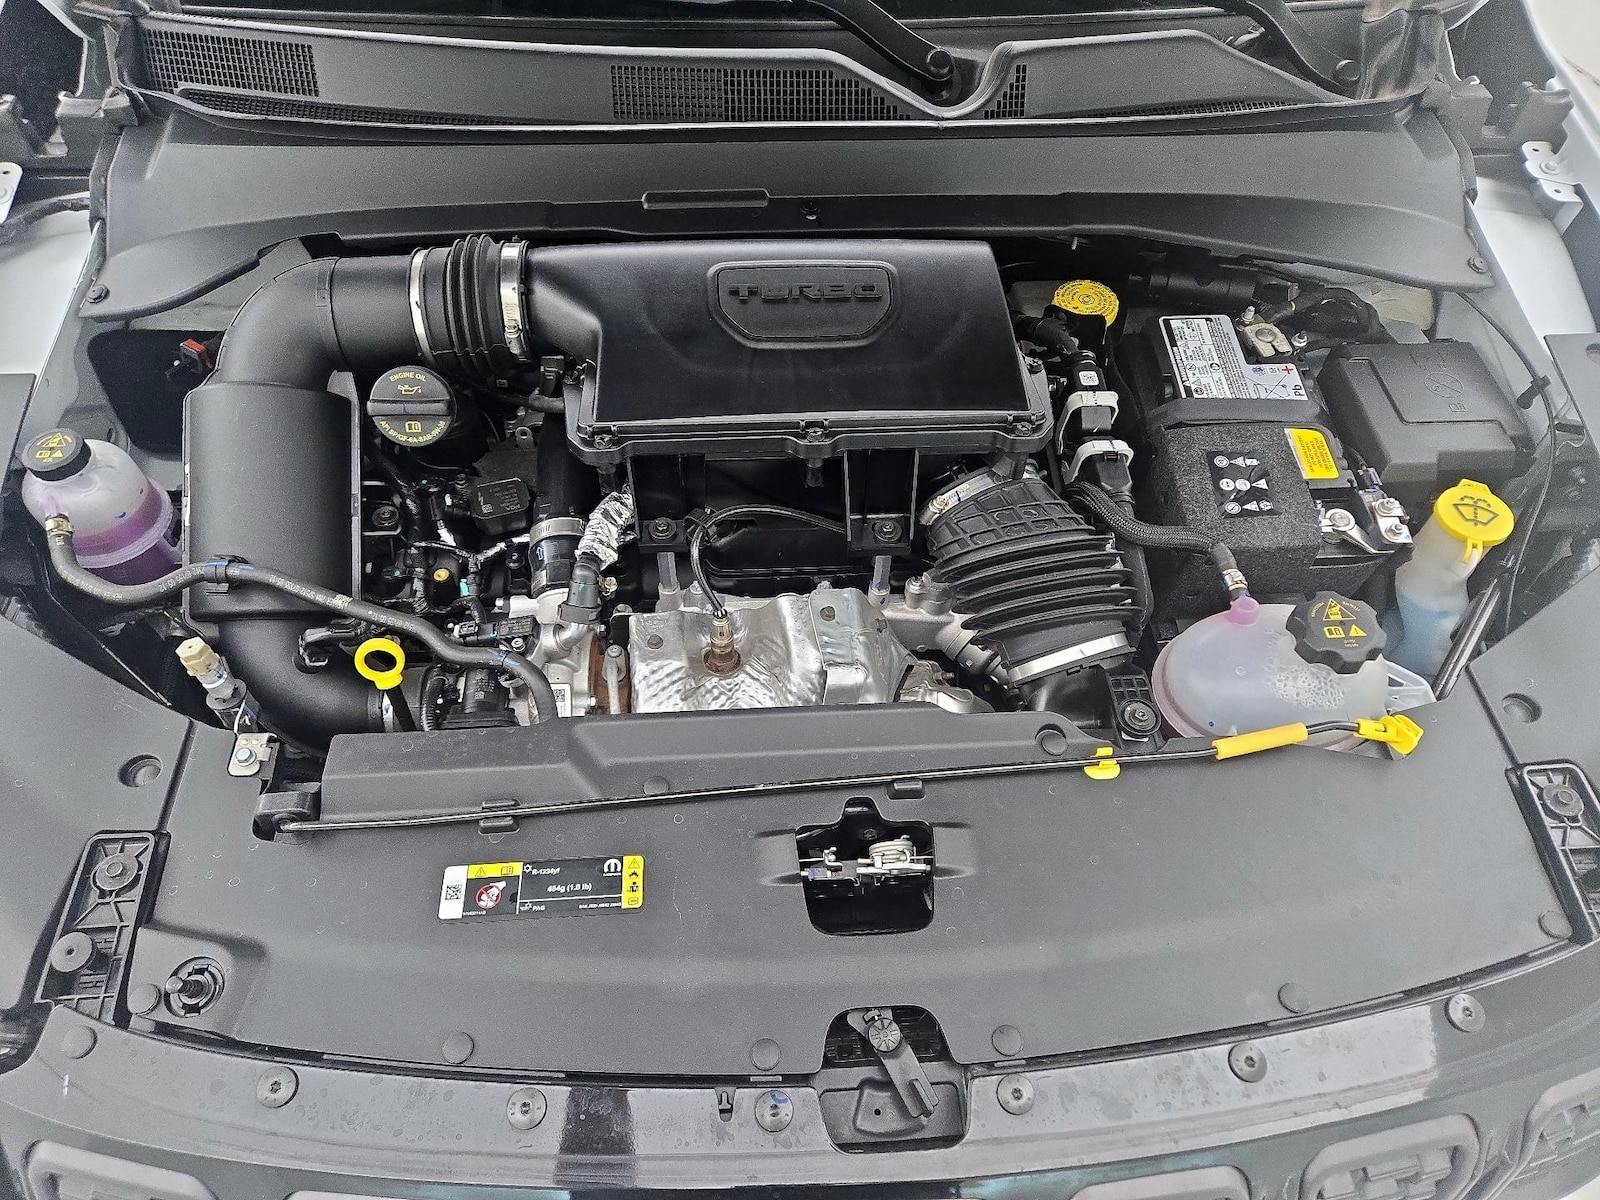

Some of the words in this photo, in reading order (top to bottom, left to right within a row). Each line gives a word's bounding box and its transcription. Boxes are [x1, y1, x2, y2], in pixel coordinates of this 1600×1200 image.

[728, 283, 884, 302] TURBO
[389, 372, 414, 382] ENGINE
[415, 372, 427, 382] OIL
[1291, 384, 1305, 397] Pb
[379, 420, 390, 431] API
[531, 867, 561, 876] R-1234yf
[546, 884, 566, 893] 454g
